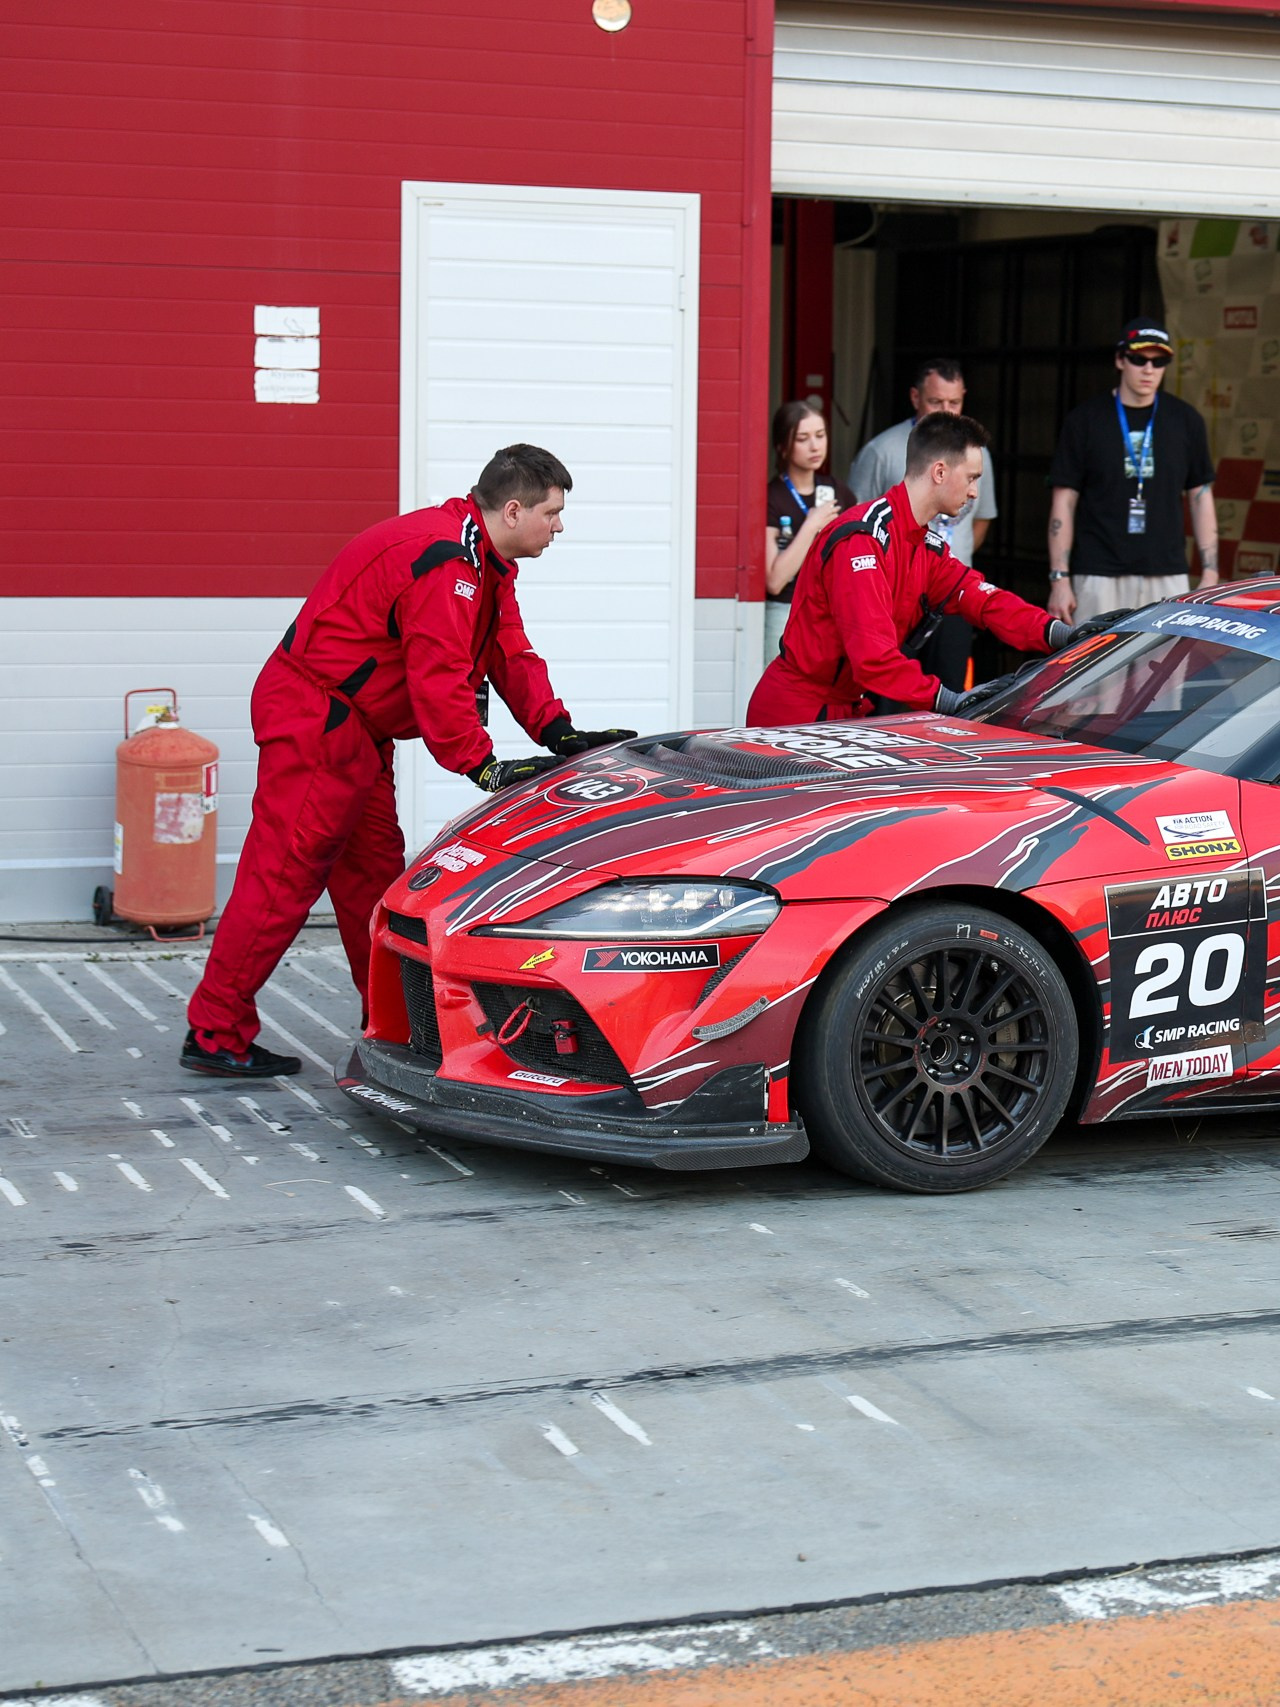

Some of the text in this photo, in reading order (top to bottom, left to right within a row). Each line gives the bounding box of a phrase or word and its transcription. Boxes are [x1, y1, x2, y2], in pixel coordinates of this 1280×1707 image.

[851, 557, 877, 570] OMP
[454, 581, 475, 598] OMP
[1170, 614, 1208, 627] SMP
[1202, 617, 1267, 640] RACING
[777, 724, 921, 746] FIRE
[720, 730, 908, 768] SMOKE
[1185, 815, 1213, 823] ACTION
[1169, 841, 1238, 857] SHONX
[1151, 878, 1228, 910] АВТО
[1145, 907, 1202, 929] ПЛЮС
[620, 950, 708, 966] YOKOHAMA
[1128, 933, 1245, 1019] 20
[1154, 1018, 1240, 1043] SMP RACING
[1151, 1052, 1229, 1081] MEN TODAY
[346, 1085, 418, 1113] YOKOHAMA
